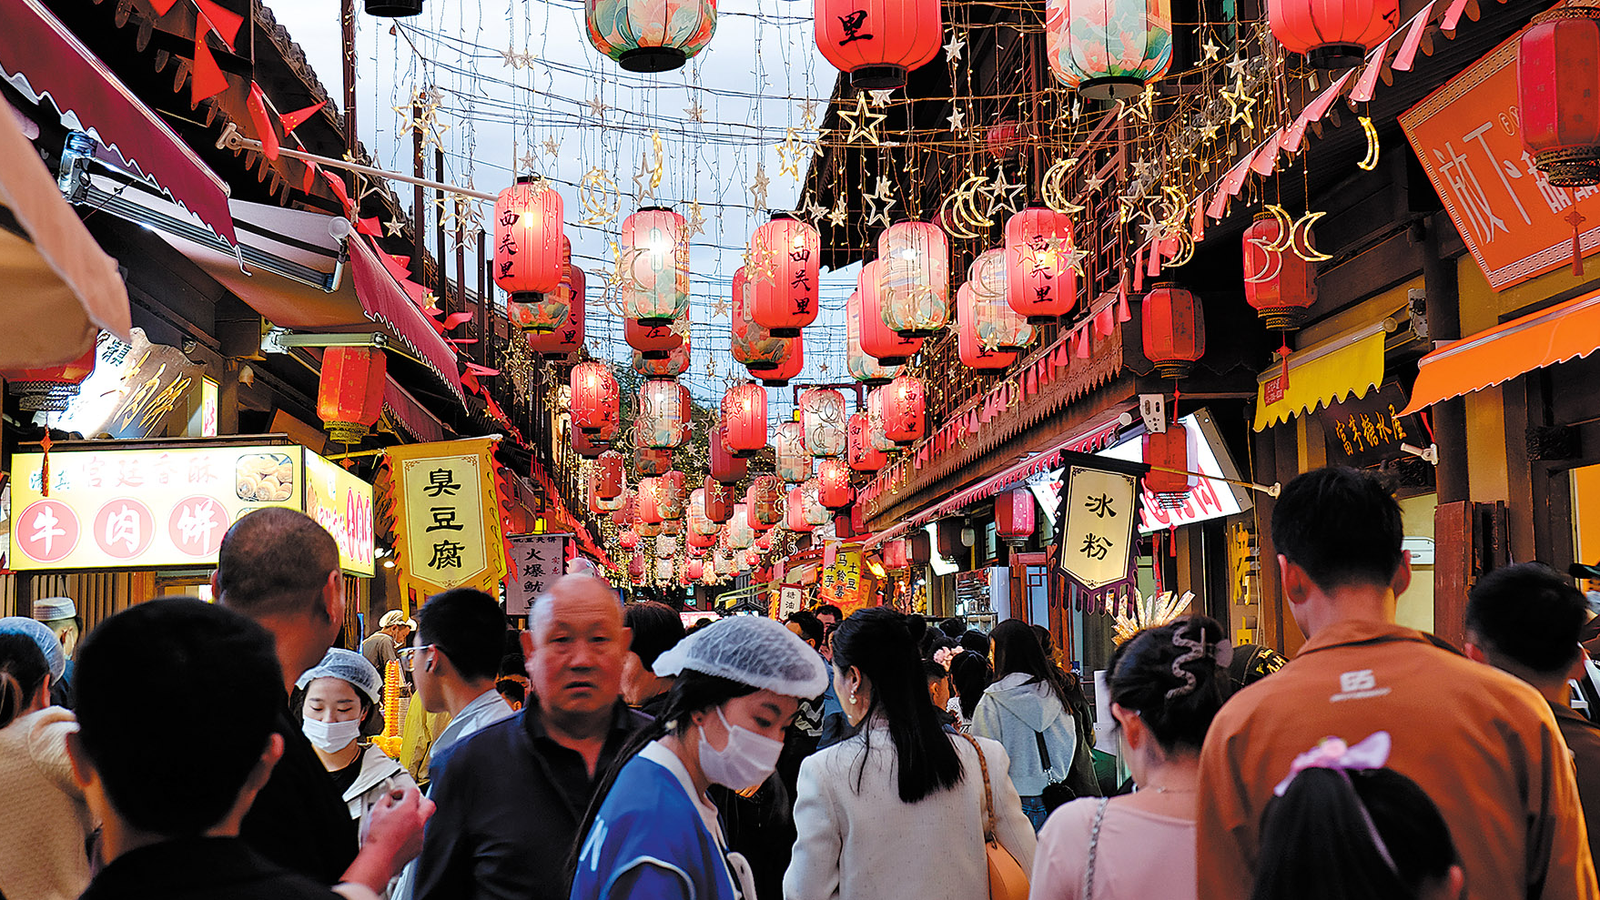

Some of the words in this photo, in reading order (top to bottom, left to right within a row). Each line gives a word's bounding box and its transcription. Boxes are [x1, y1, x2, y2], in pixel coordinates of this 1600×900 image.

[838, 10, 874, 46] 里
[499, 210, 520, 280] 西关里
[1028, 235, 1054, 303] 西关里
[789, 245, 811, 315] 西关里
[30, 498, 219, 556] 牛肉饼
[423, 468, 466, 570] 臭豆腐
[1080, 493, 1117, 561] 冰粉
[835, 554, 847, 597] 马铃薯
[846, 562, 858, 590] 土豆
